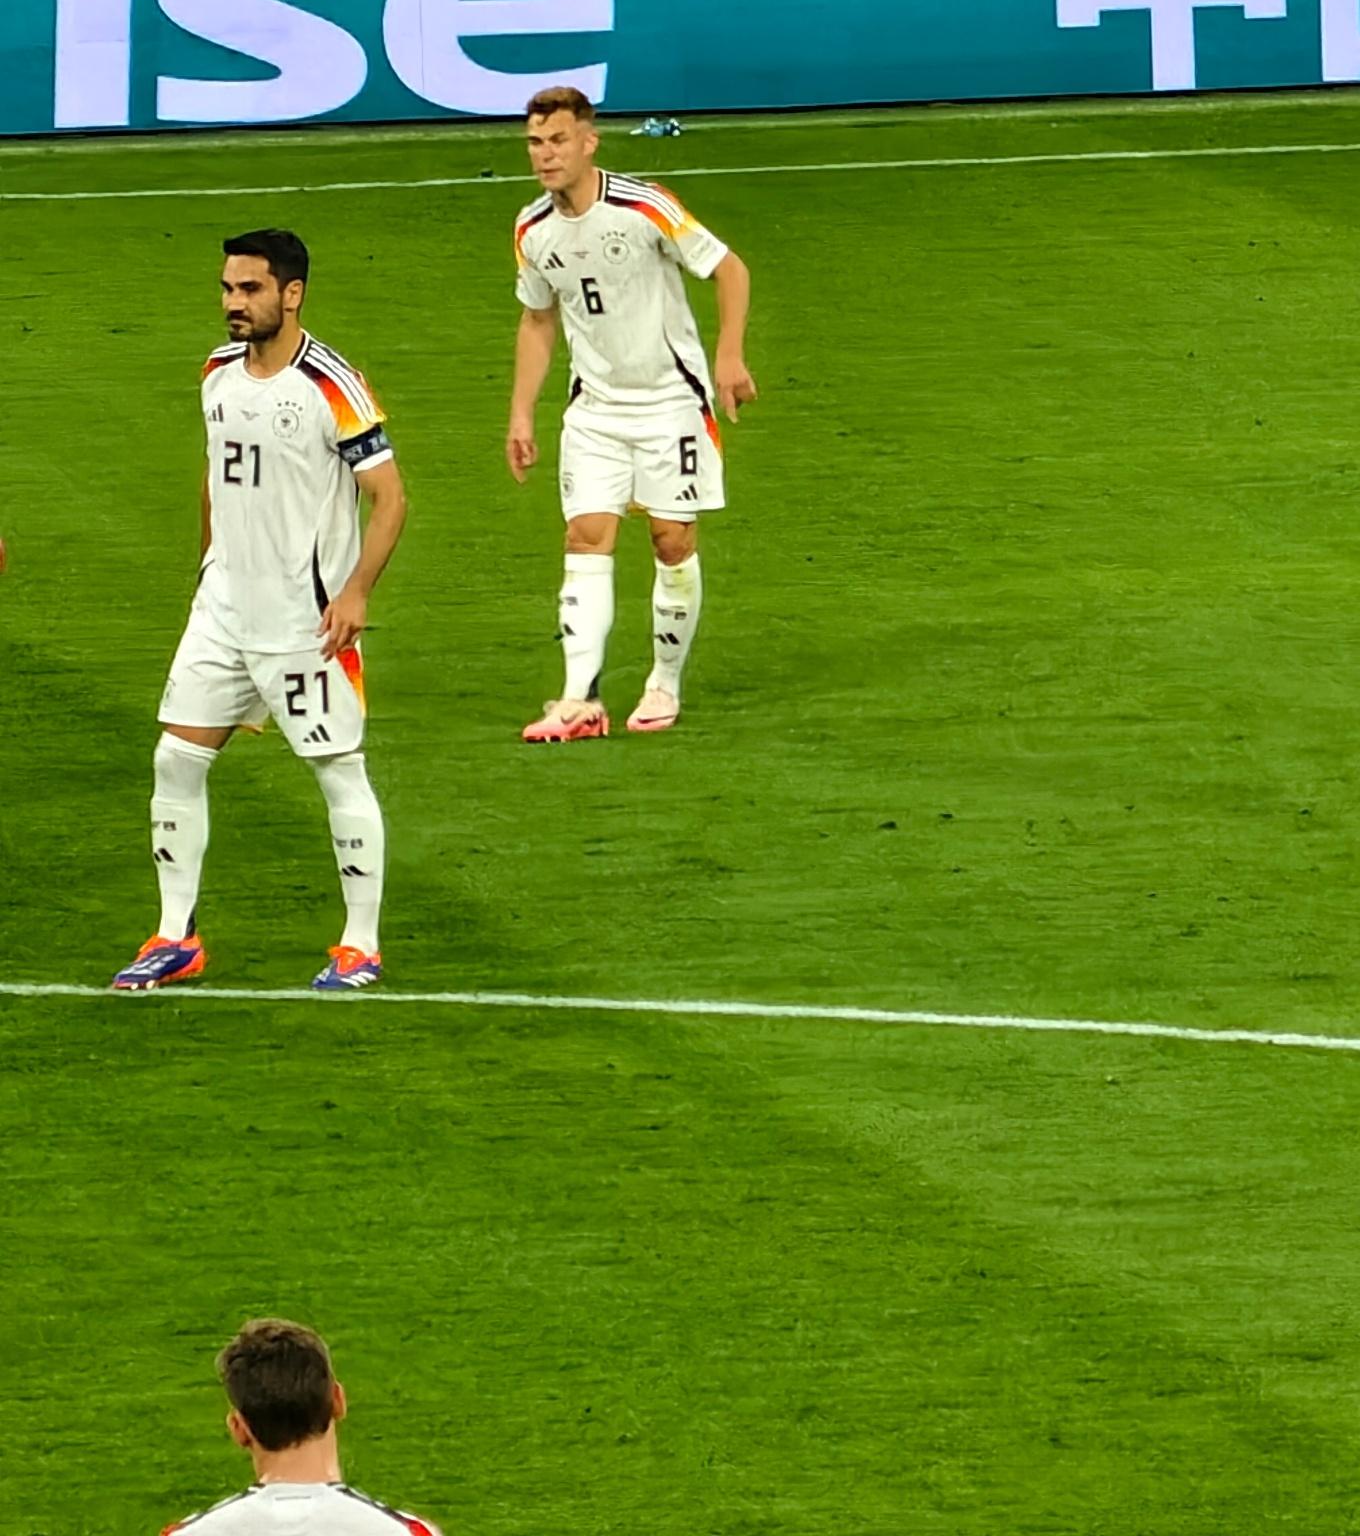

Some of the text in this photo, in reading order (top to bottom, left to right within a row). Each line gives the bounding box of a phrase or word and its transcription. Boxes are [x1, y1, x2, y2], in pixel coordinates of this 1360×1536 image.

[580, 276, 604, 315] 6
[223, 440, 261, 488] 21
[679, 435, 698, 476] 6
[284, 671, 329, 717] 21
